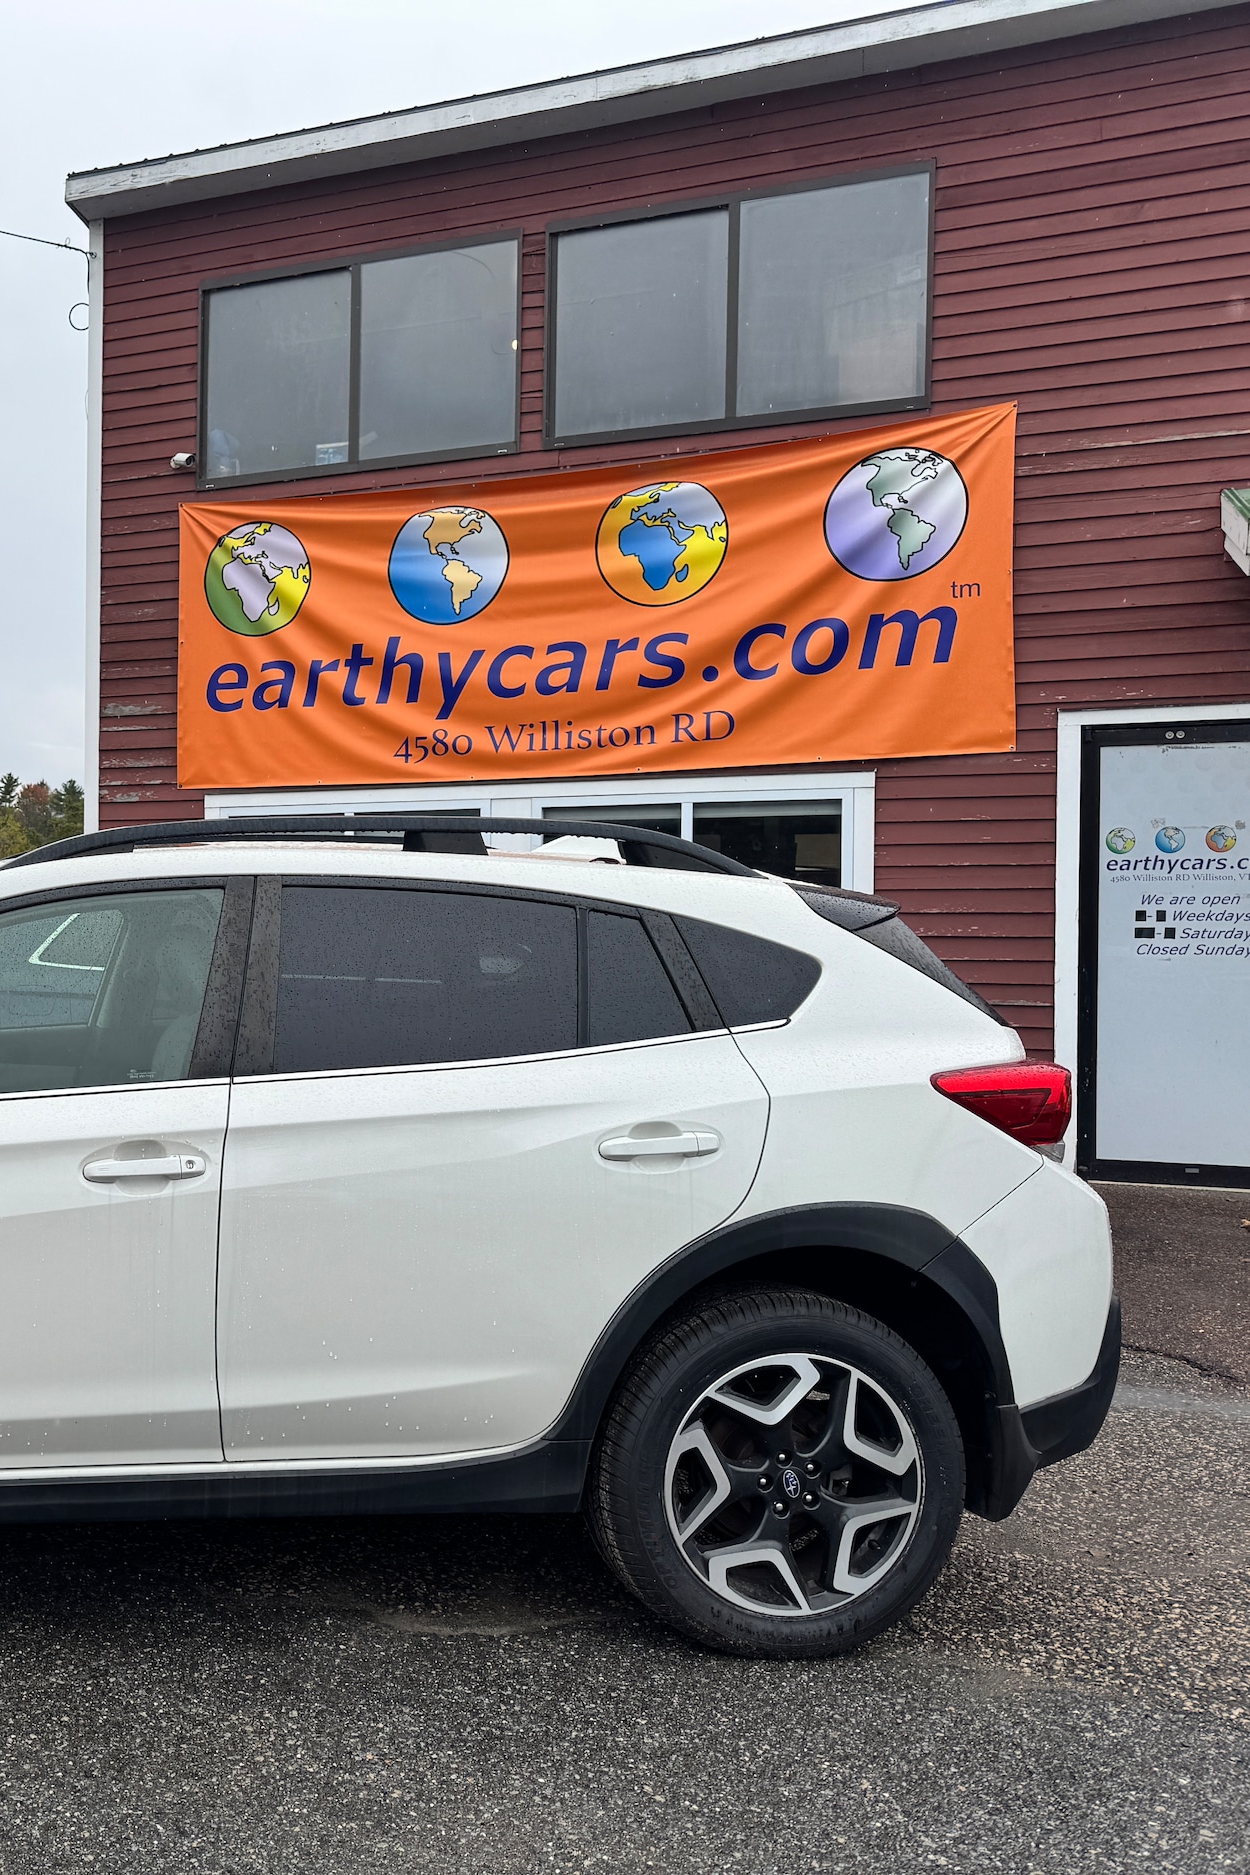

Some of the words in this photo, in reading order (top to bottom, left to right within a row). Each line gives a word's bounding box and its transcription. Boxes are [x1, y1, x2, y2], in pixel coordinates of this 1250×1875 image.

[206, 606, 958, 720] earthycars.com
[950, 580, 981, 599] tm
[393, 728, 473, 763] 4580
[485, 720, 657, 754] Williston
[671, 710, 735, 743] RD
[1106, 855, 1250, 874] earthycars.c
[1110, 874, 1131, 883] 4580
[1132, 873, 1172, 882] Williston
[1175, 873, 1191, 881] RD
[1141, 894, 1164, 905] We
[1169, 895, 1196, 905] are
[1202, 895, 1241, 907] open
[1173, 909, 1250, 924] Weekdays
[1136, 944, 1190, 956] Closed
